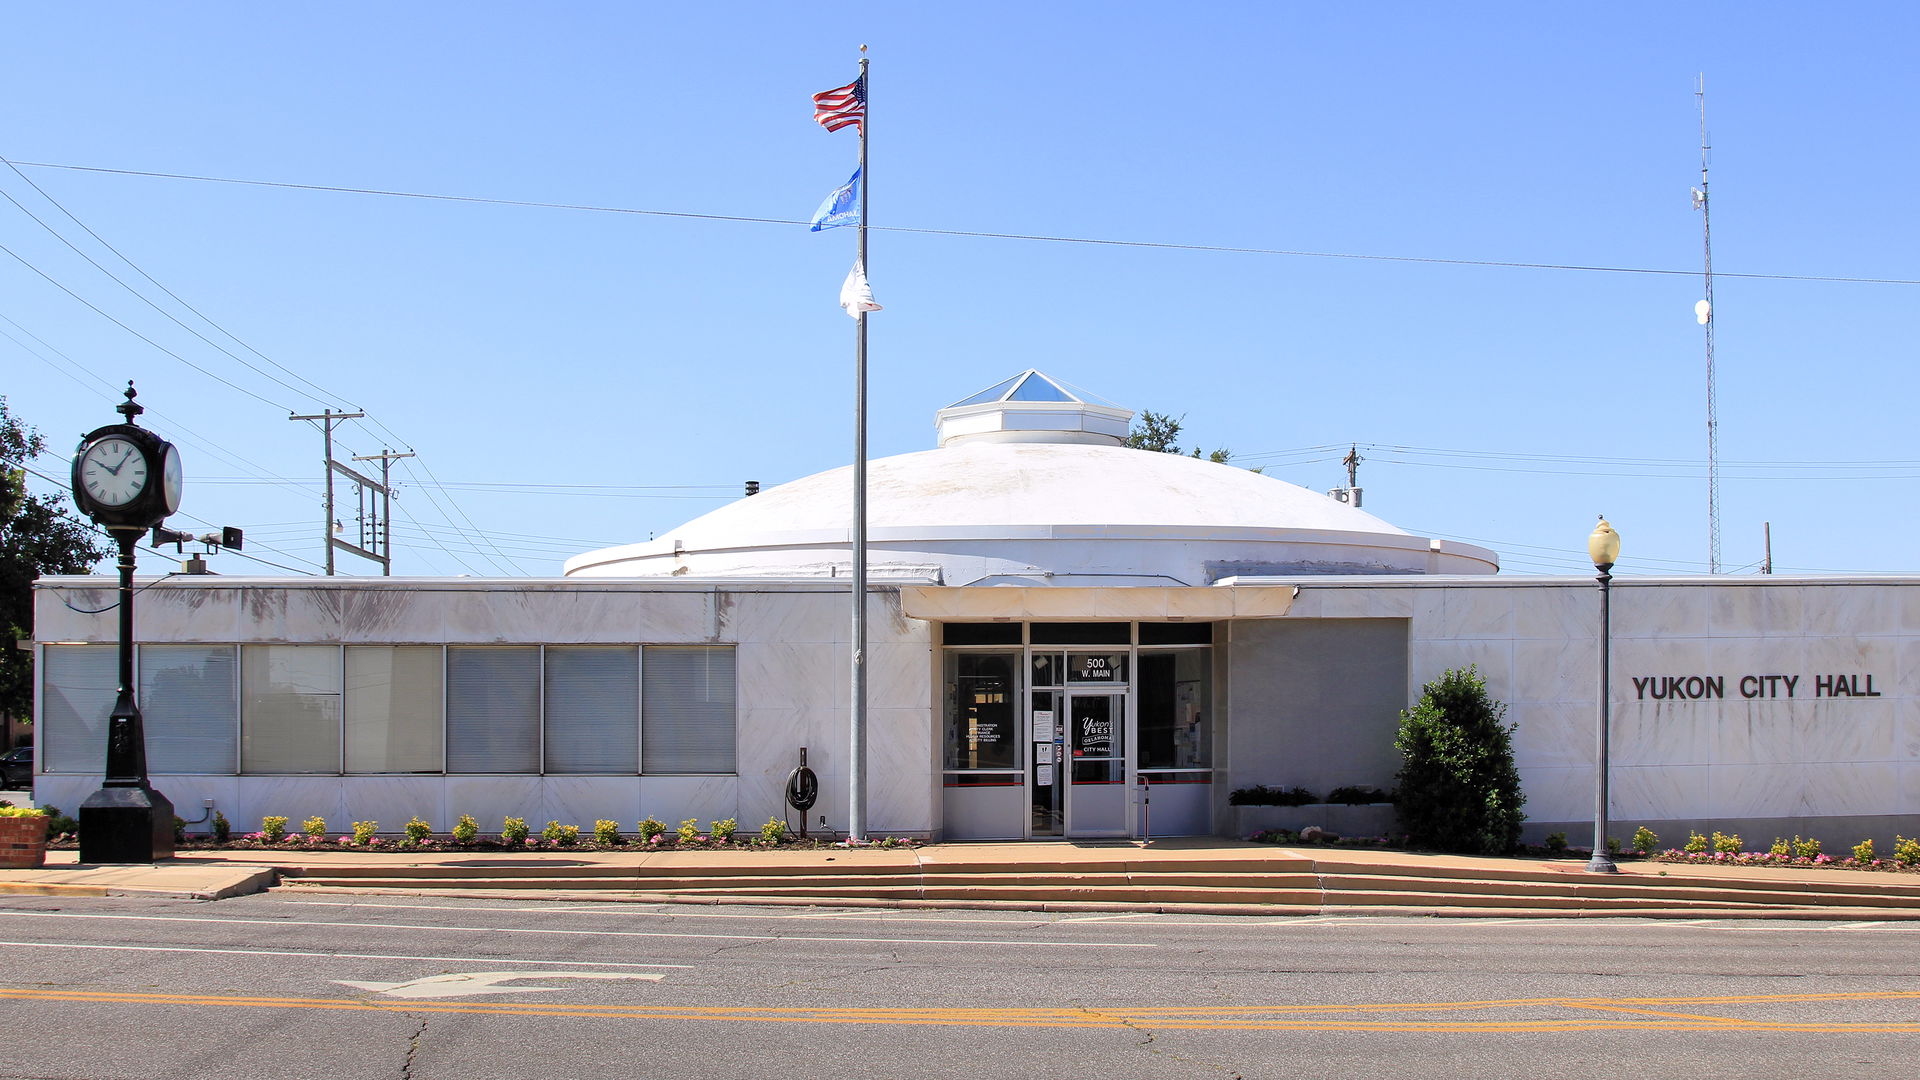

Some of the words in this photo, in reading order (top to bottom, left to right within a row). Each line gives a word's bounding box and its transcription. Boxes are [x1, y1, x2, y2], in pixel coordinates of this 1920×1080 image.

[1087, 658, 1105, 668] 500
[1081, 670, 1091, 678] W.
[1632, 676, 1724, 700] YUKON
[1739, 675, 1799, 698] CITY
[1815, 674, 1881, 697] HALL
[1083, 735, 1112, 743] OKLAHOMA
